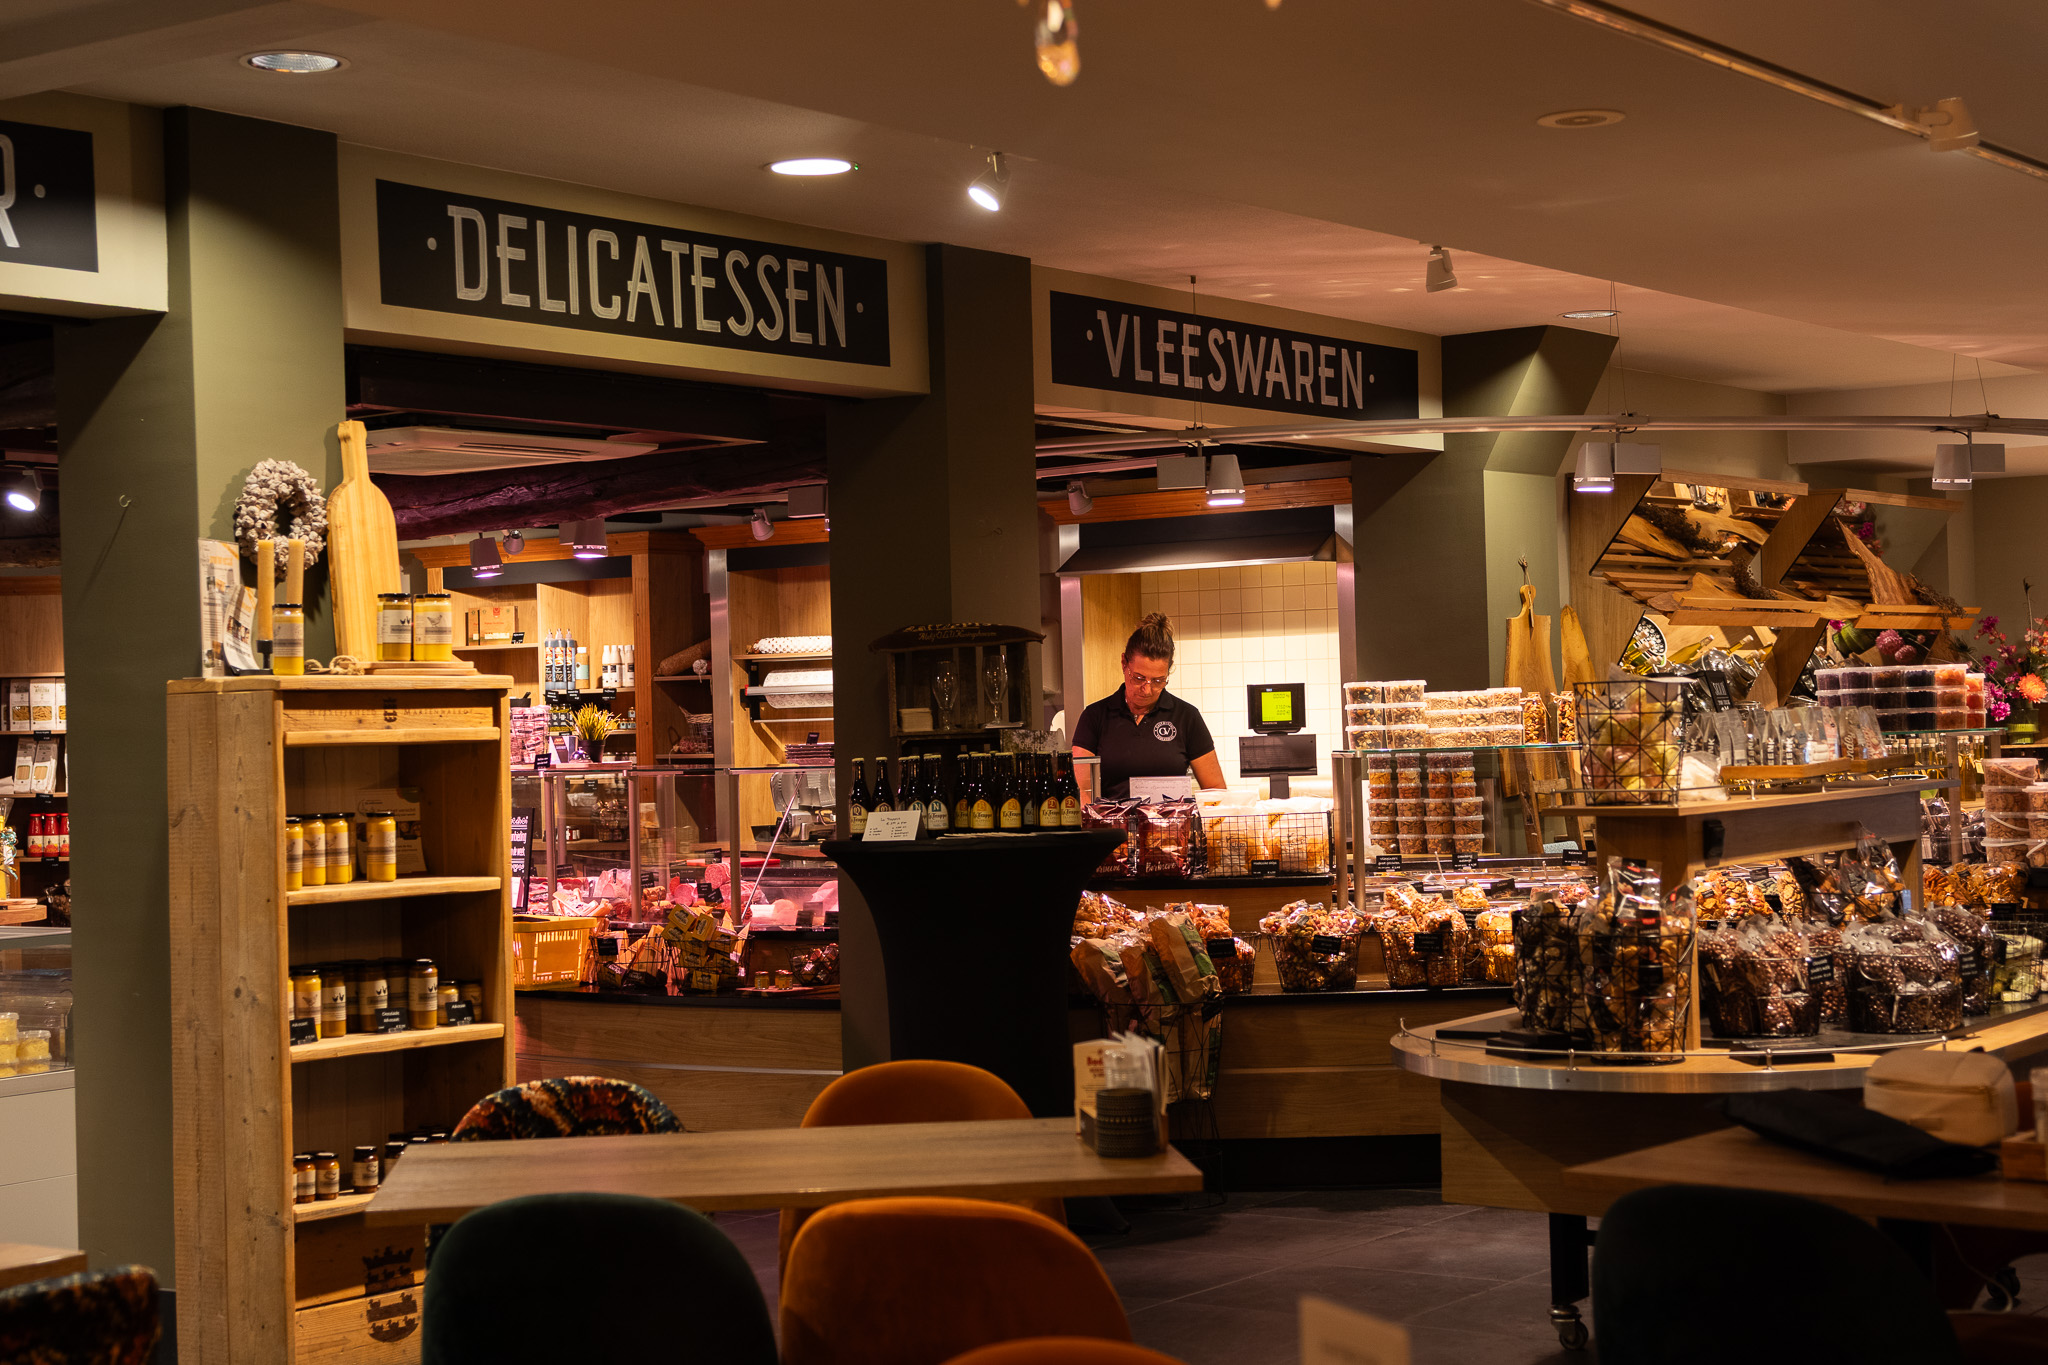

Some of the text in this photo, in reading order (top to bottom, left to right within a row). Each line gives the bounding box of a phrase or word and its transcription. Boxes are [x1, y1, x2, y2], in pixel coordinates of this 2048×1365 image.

[0, 133, 20, 248] R
[447, 204, 847, 349] DELICATESSEN
[1097, 309, 1364, 410] VLEESWAREN
